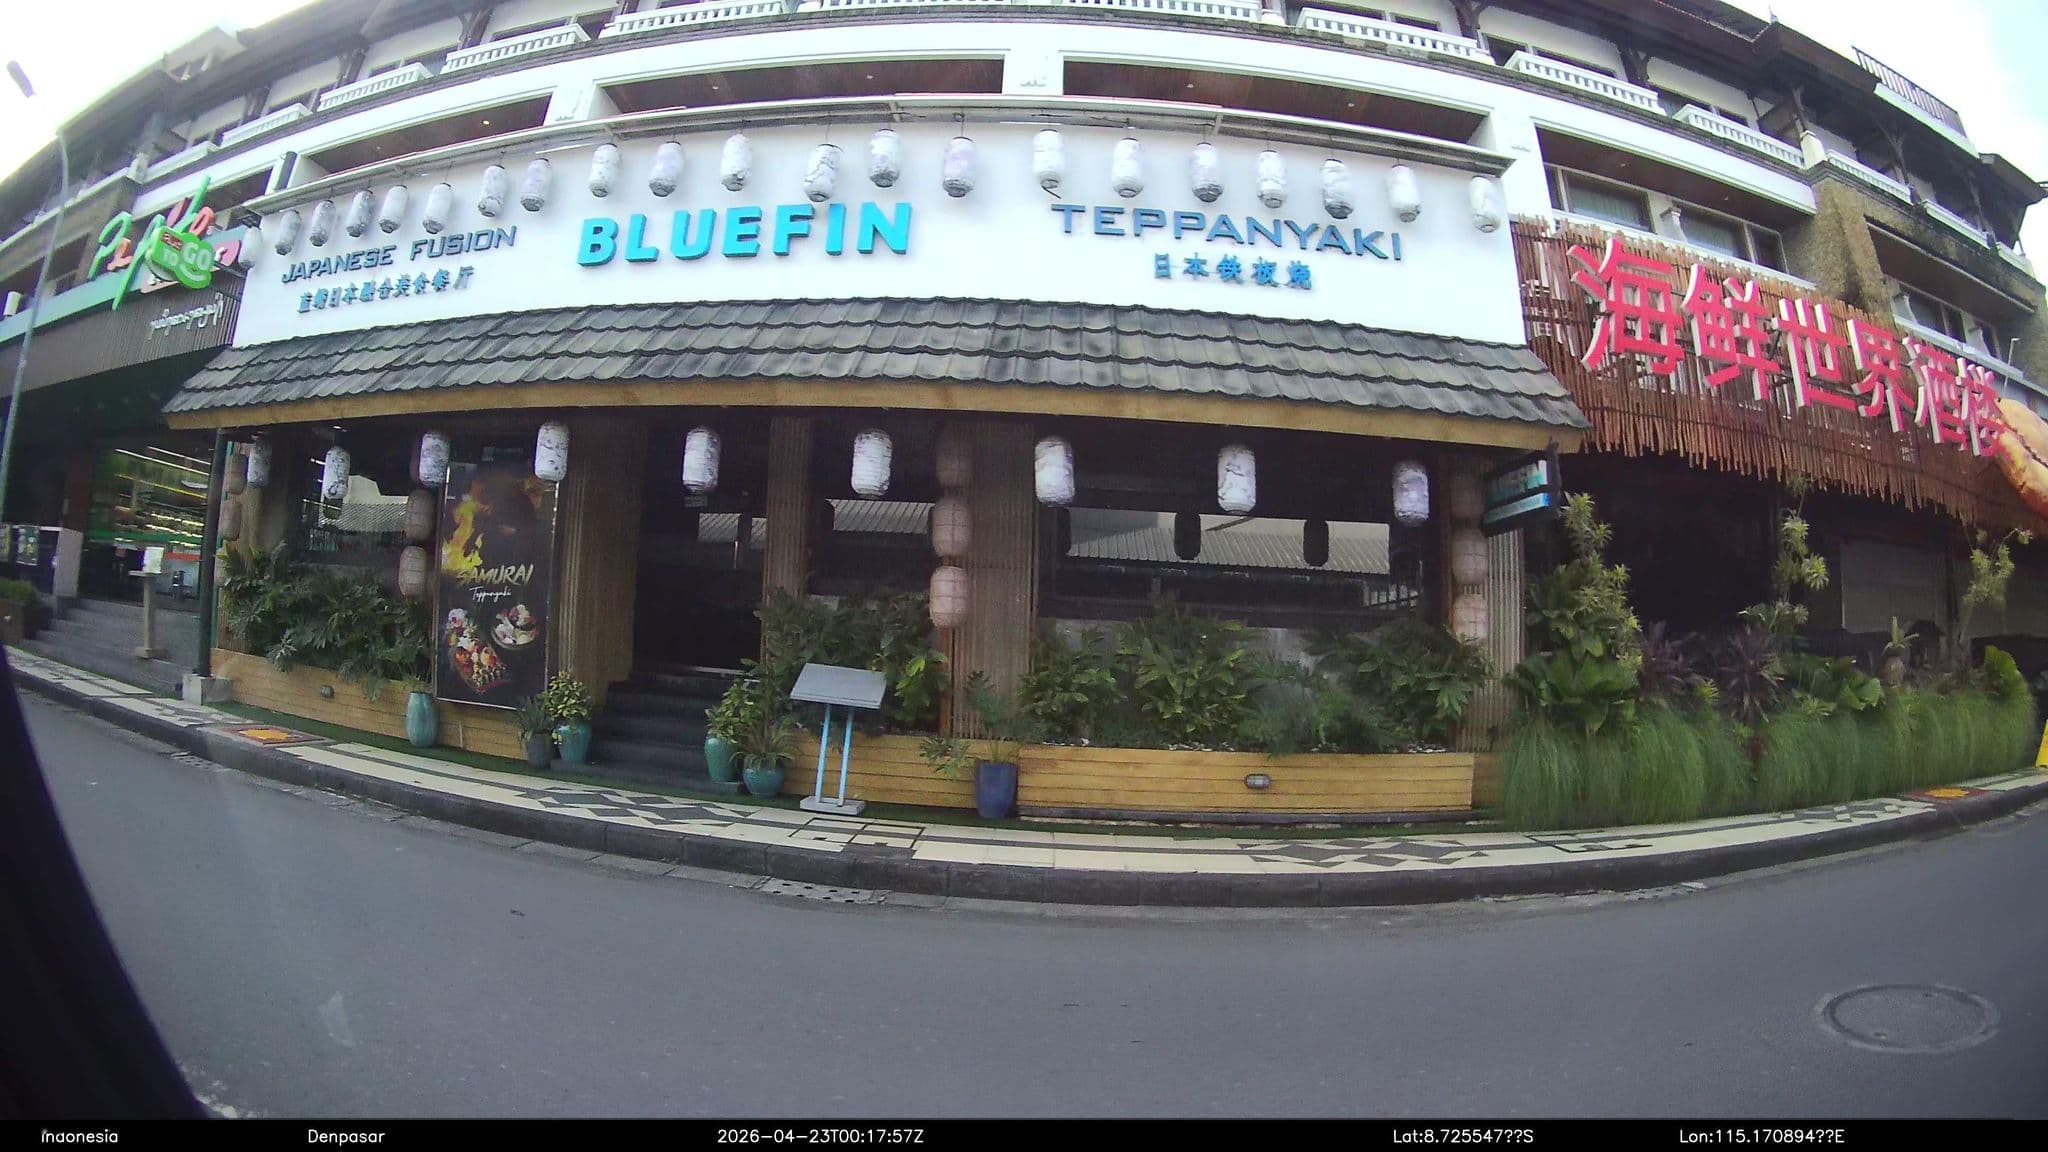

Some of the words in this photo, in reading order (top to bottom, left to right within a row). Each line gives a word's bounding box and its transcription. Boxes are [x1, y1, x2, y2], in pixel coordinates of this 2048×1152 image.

[281, 245, 397, 284] JAPANESE
[410, 225, 518, 260] FUSION
[577, 202, 912, 267] BLUEFIN
[1051, 203, 1402, 261] TEPPANYAKI
[1566, 237, 2008, 458] 海鲜世界酒楼
[456, 563, 535, 587] SAMURAI
